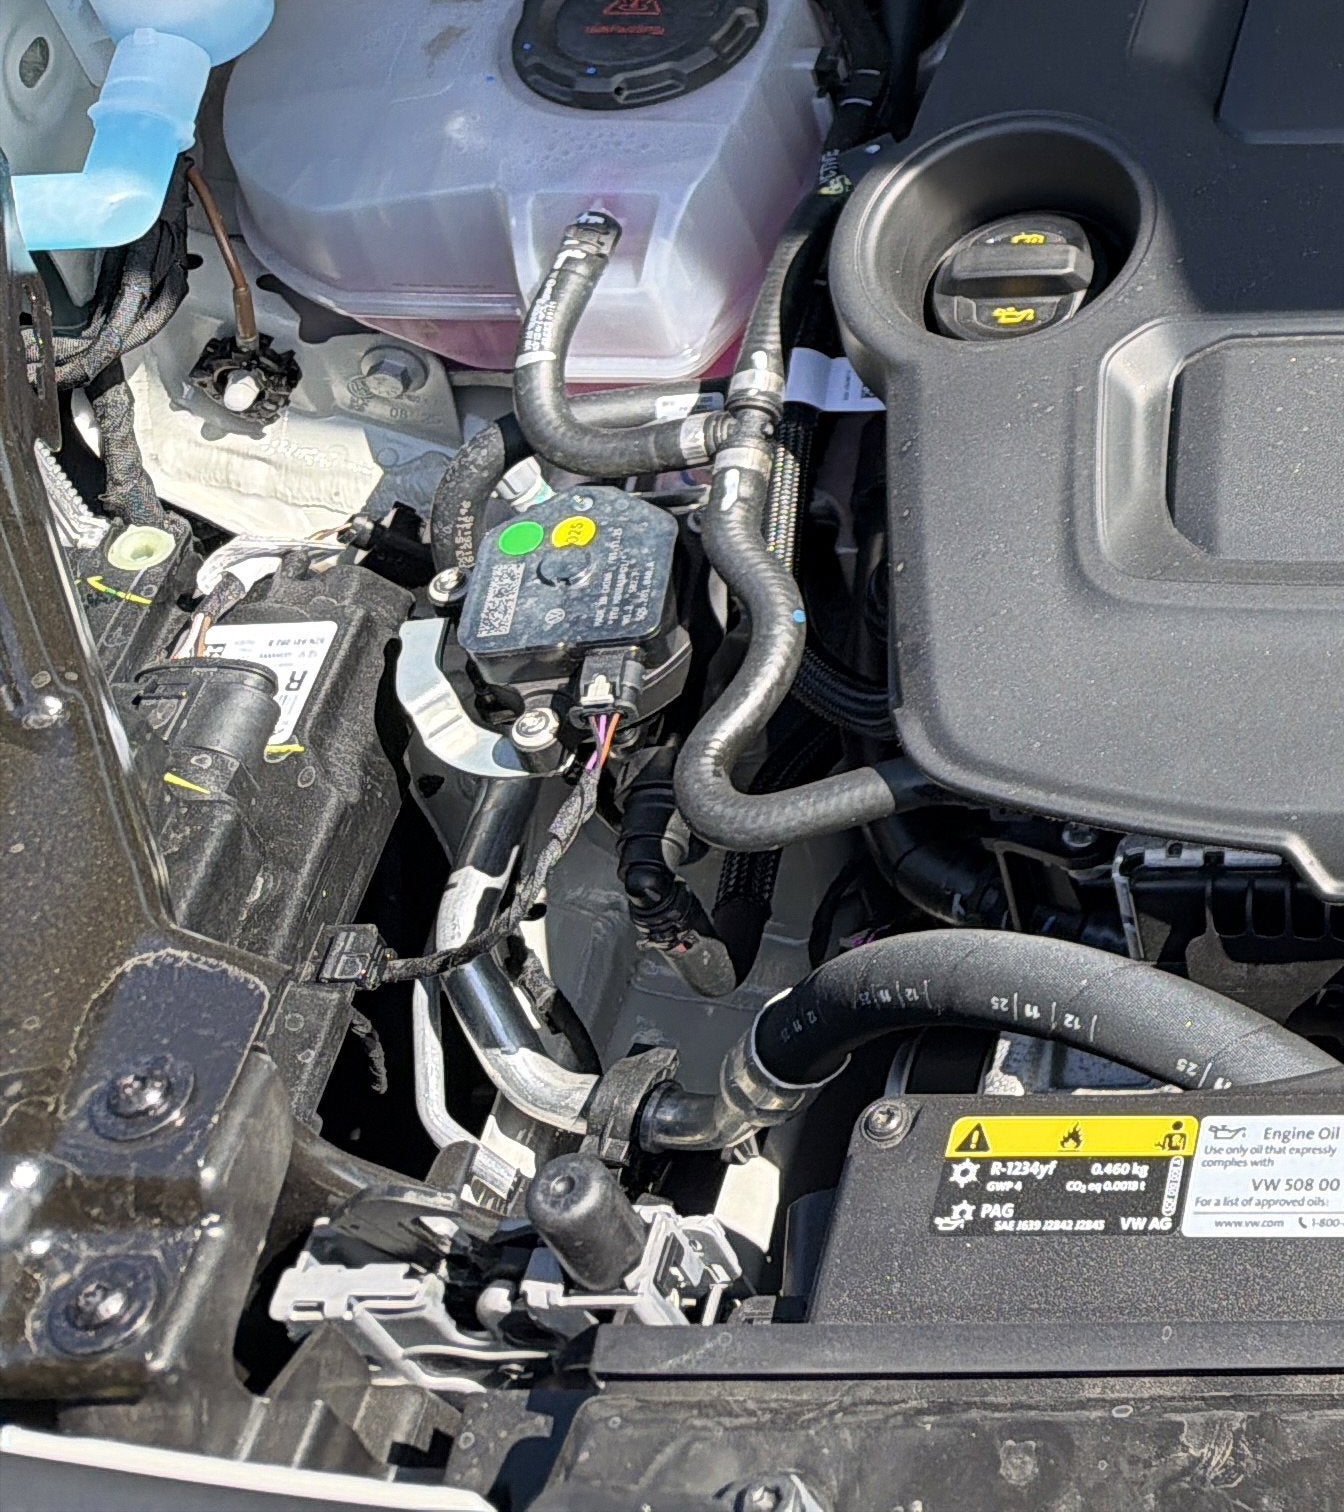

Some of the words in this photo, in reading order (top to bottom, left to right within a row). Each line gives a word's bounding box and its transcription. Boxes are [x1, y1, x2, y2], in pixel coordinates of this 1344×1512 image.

[285, 670, 308, 692] R
[991, 996, 1010, 1011] 25
[1064, 1013, 1082, 1030] 12
[1263, 1127, 1315, 1143] Engine
[1318, 1126, 1341, 1140] Oil
[1204, 1145, 1224, 1155] Use
[1225, 1145, 1249, 1157] only
[1250, 1144, 1264, 1155] oil
[1265, 1144, 1286, 1155] that
[1288, 1145, 1338, 1157] expressly
[990, 1159, 1059, 1180] R-1234yf
[1090, 1163, 1130, 1176] 0.460
[1131, 1161, 1150, 1179] kg
[1201, 1159, 1248, 1170] complies
[1250, 1158, 1275, 1168] with
[985, 1181, 1013, 1192] GWP
[1251, 1178, 1281, 1191] VW
[1284, 1178, 1314, 1191] 508
[1318, 1178, 1341, 1191] 00
[1195, 1196, 1212, 1207] For
[1222, 1196, 1239, 1207] list
[1241, 1196, 1253, 1207] of
[1255, 1196, 1305, 1209] approved
[980, 1203, 1015, 1218] PAG
[994, 1220, 1015, 1231] SAE
[1120, 1216, 1148, 1230] VW
[1148, 1216, 1173, 1230] AG
[1214, 1219, 1284, 1228] www.vw.com
